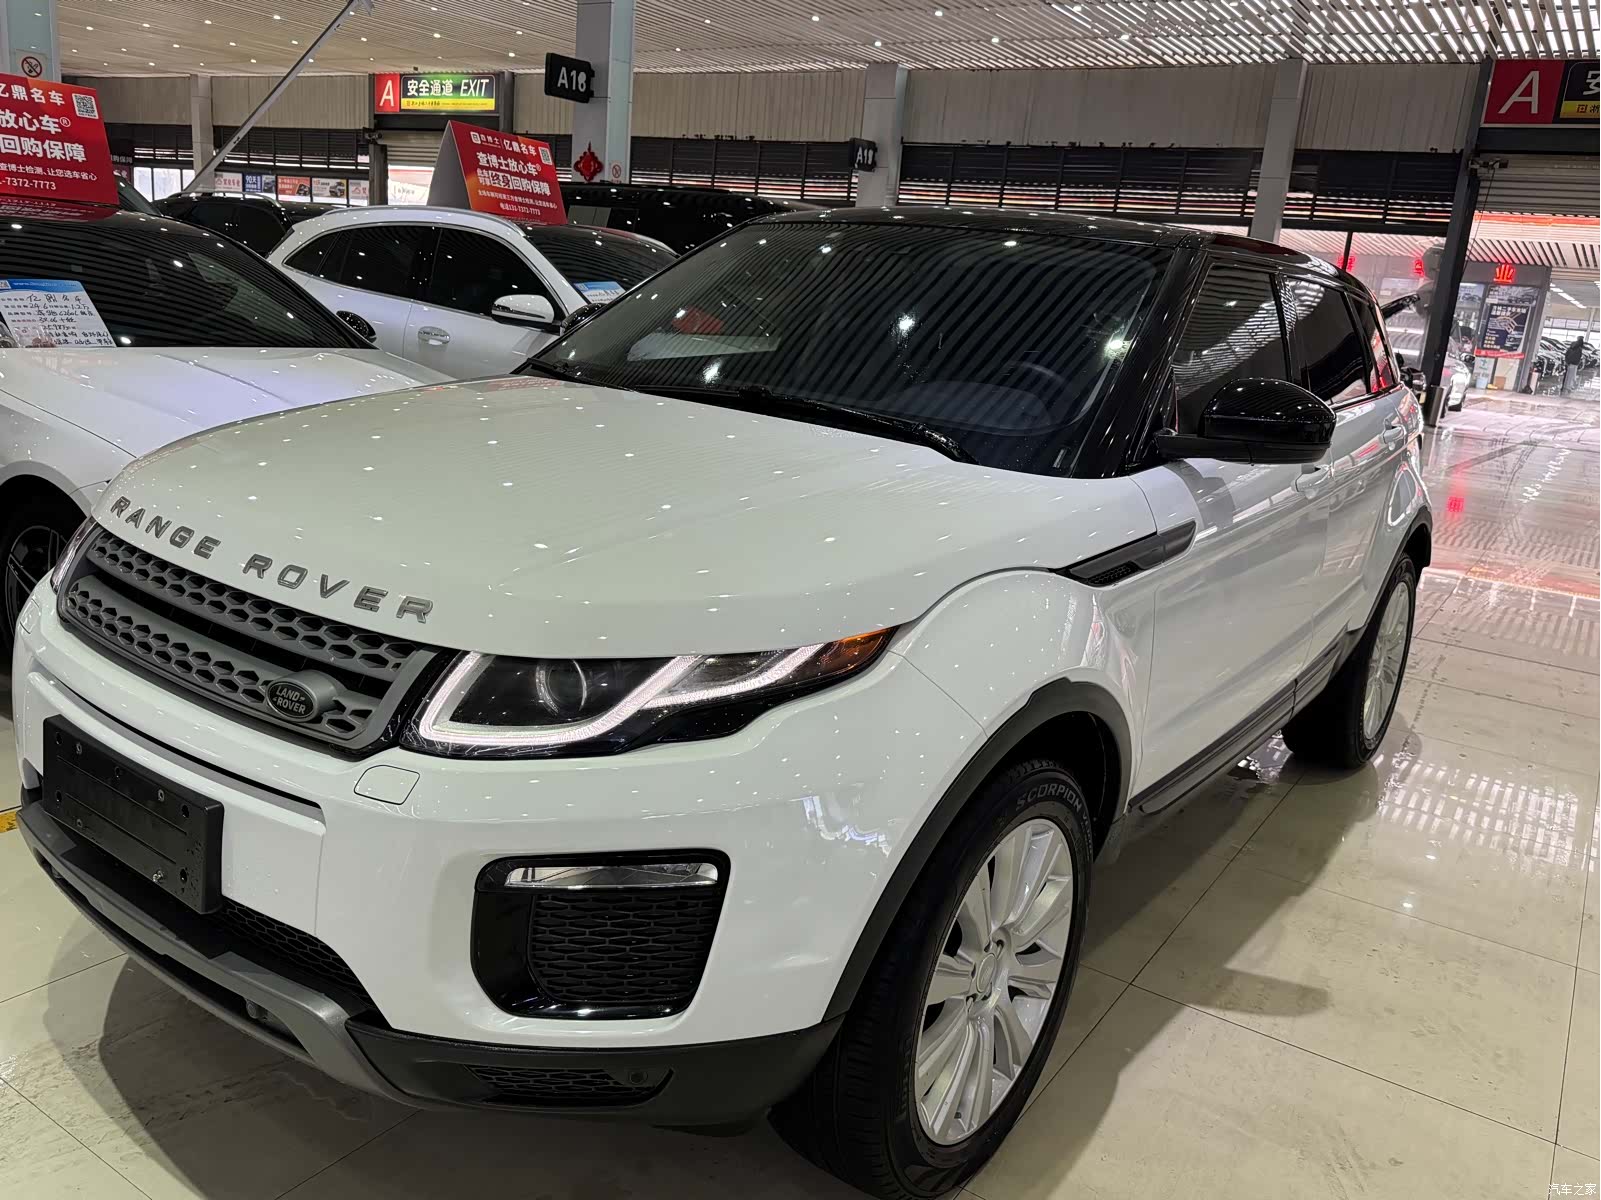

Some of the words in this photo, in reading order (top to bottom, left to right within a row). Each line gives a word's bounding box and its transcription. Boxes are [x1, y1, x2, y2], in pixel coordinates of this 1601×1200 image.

[379, 79, 395, 107] A
[407, 79, 453, 97] 安全通道
[460, 79, 490, 97] EXIT
[1498, 70, 1540, 114] A
[0, 134, 87, 162] 回购保障
[0, 177, 57, 190] -7372-7773
[110, 495, 221, 559] RANGE
[242, 553, 434, 624] ROVER
[276, 696, 307, 715] ROVER
[1016, 783, 1082, 812] SCORPION
